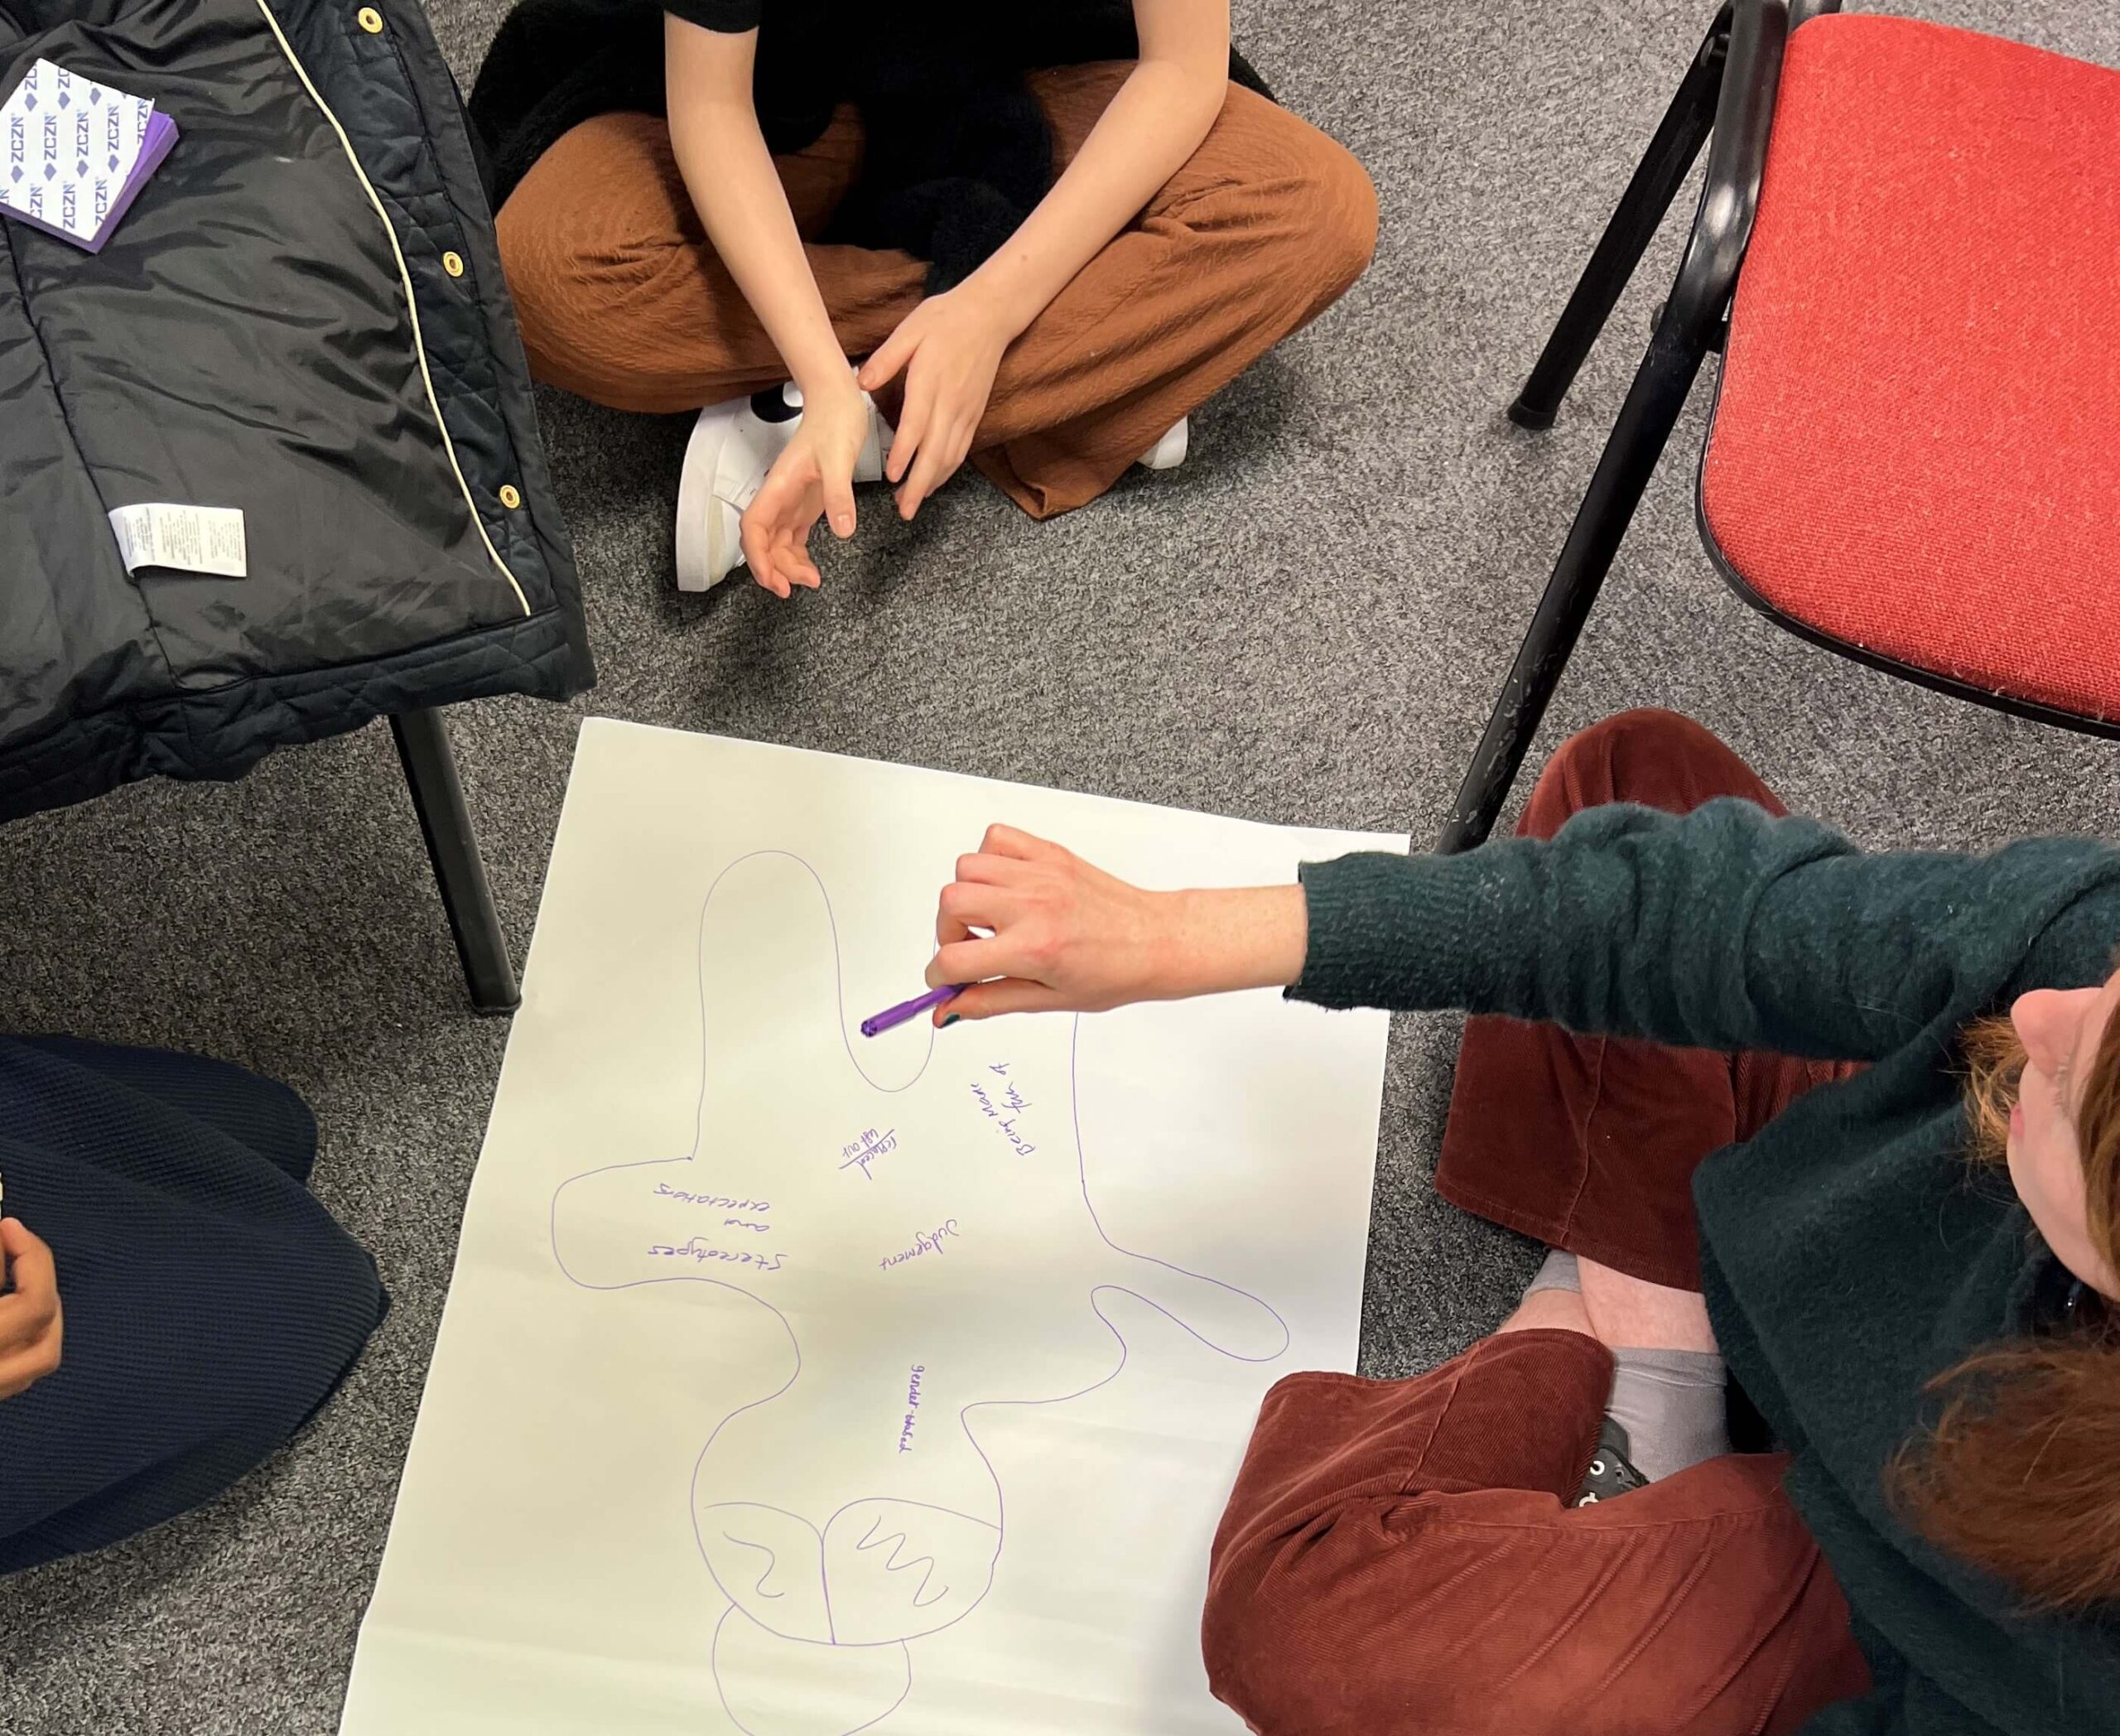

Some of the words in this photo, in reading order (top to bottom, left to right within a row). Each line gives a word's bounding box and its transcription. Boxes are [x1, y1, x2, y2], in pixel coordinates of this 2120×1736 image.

[11, 117, 24, 162] ZCZN
[44, 115, 57, 160] ZCZN
[76, 112, 89, 157] ZCZN
[108, 106, 119, 152] ZCZN
[30, 187, 42, 219] CZN
[63, 184, 75, 229] ZCZN
[988, 1063, 1011, 1077] of
[1000, 1081, 1034, 1115] fun
[998, 1118, 1037, 1157] Being
[723, 1218, 770, 1232] and
[878, 1218, 960, 1271] Judgement
[647, 1237, 789, 1271] Stereotypes
